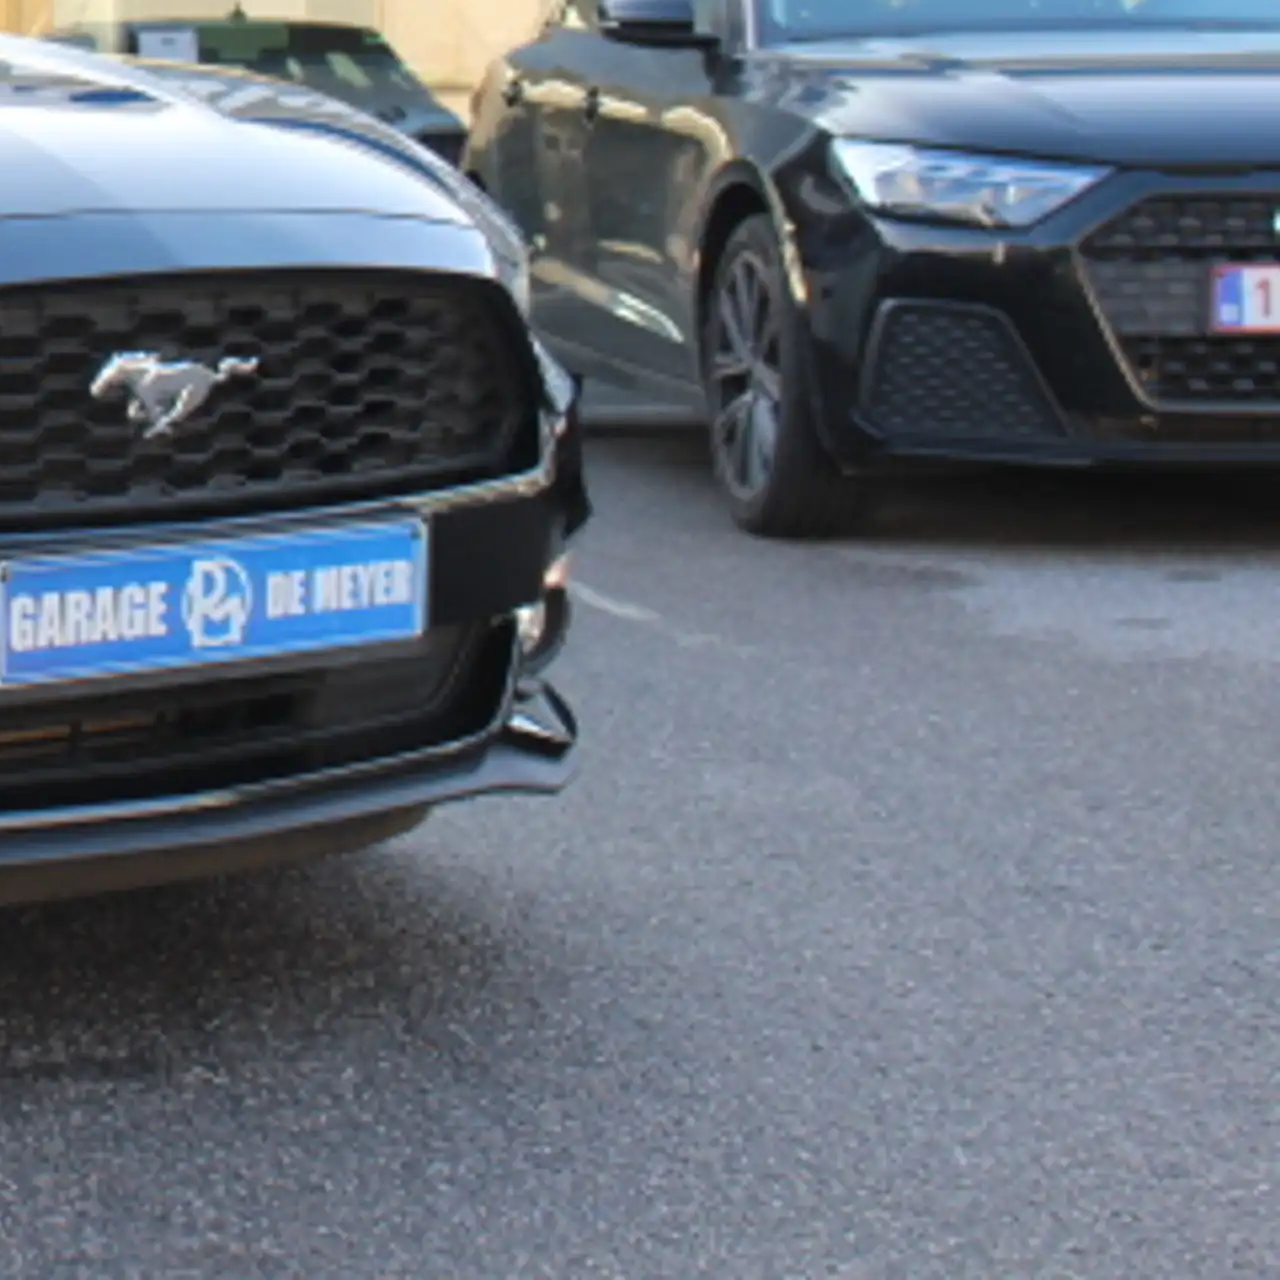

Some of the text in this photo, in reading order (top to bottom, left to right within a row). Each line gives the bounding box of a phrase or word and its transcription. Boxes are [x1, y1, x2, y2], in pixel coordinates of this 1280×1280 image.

[9, 582, 168, 652] GARAGE
[266, 570, 306, 619] DE
[313, 559, 414, 612] MEYER
